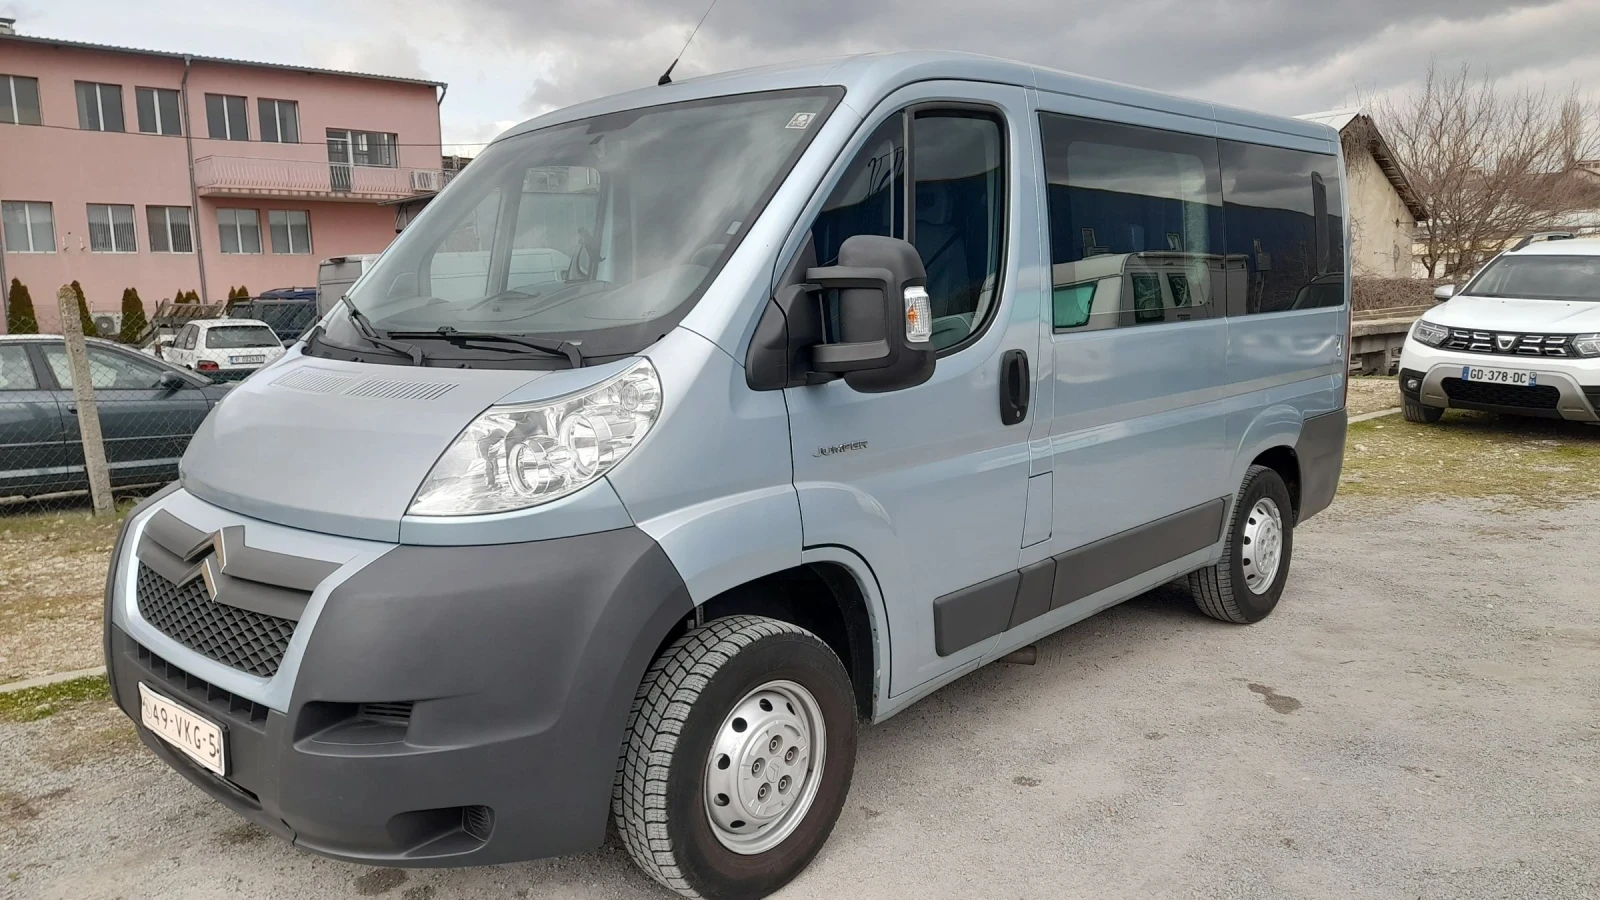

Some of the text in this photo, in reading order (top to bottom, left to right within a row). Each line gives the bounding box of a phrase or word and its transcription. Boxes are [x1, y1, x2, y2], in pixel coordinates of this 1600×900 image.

[1470, 368, 1527, 384] GD-378-DC
[812, 440, 869, 458] JUMPER
[153, 703, 217, 758] 49-VKG-5
